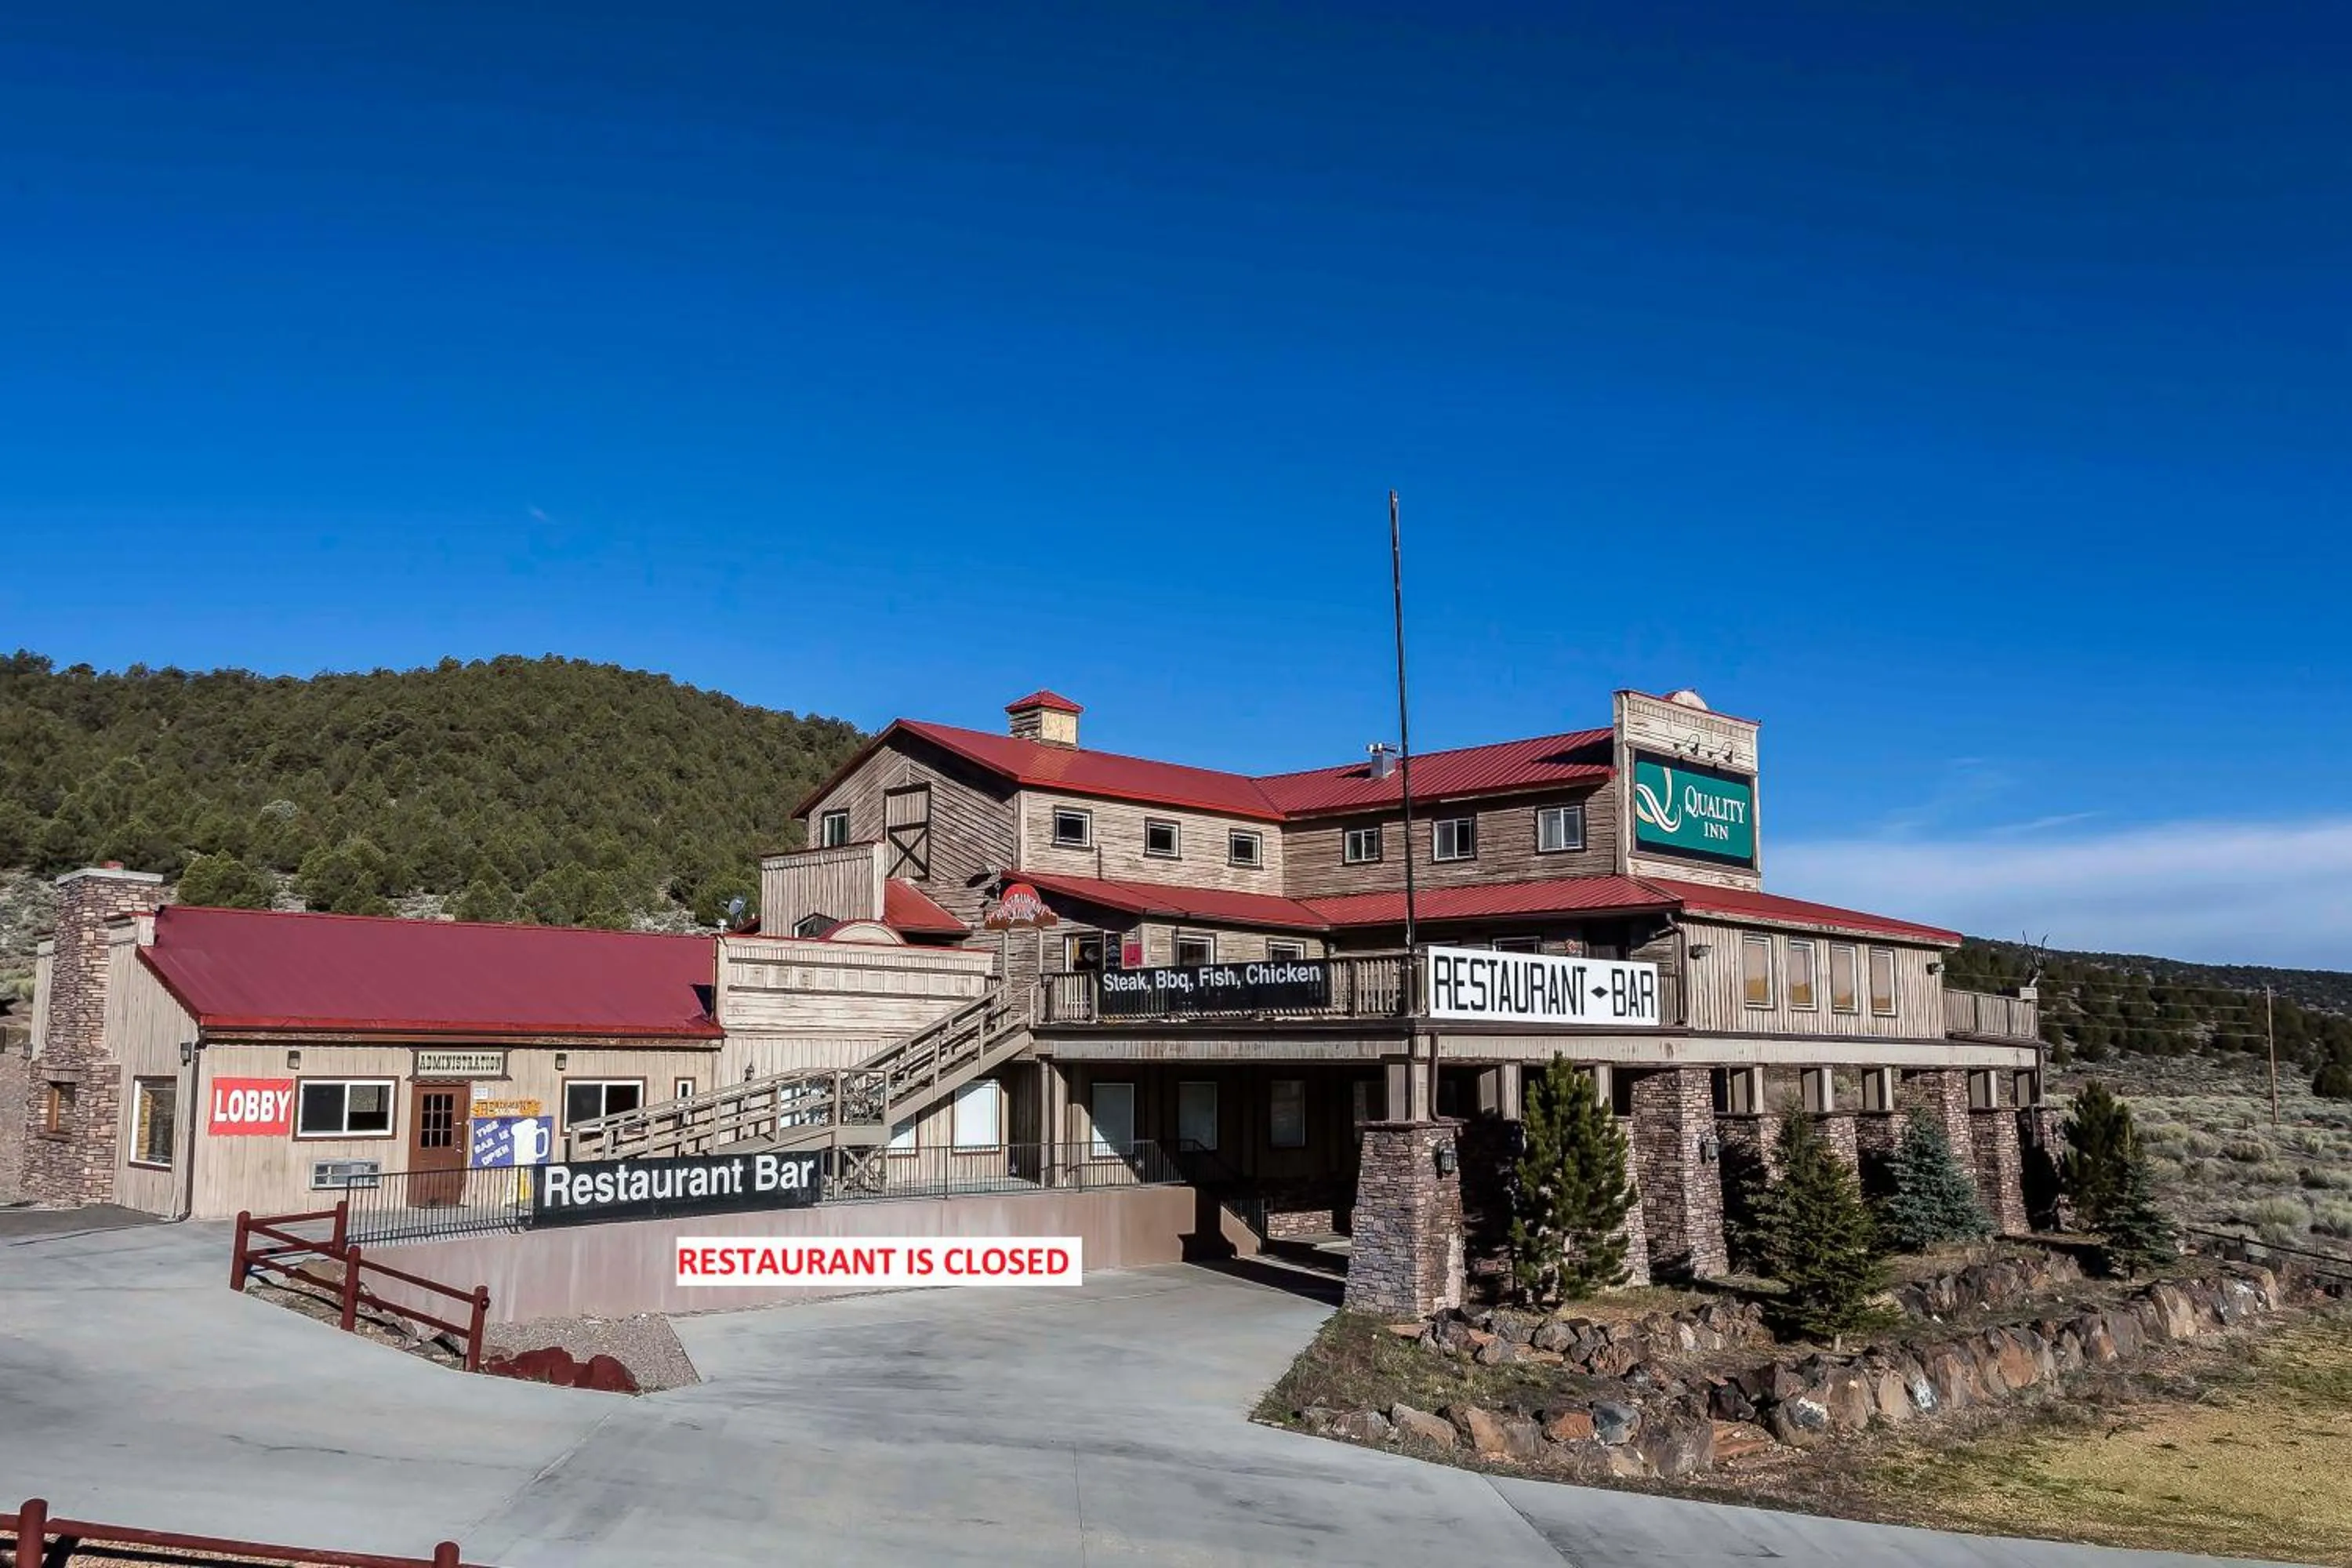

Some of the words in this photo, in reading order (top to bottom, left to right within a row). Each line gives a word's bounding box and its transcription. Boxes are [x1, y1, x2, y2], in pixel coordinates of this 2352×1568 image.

[1685, 785, 1745, 824] QUALITY
[1704, 822, 1729, 841] INN
[1103, 971, 1151, 993] Steak,
[1156, 970, 1194, 993] Bbq,
[1199, 965, 1241, 989] Fish,
[1246, 962, 1322, 985] Chicken
[1434, 956, 1587, 1017] RESTAURANT
[1611, 968, 1654, 1018] BAR
[419, 1054, 501, 1071] ADMINISTRATION
[213, 1088, 292, 1123] LOBBY
[543, 1158, 744, 1207] Restaurant
[754, 1155, 815, 1192] Bar
